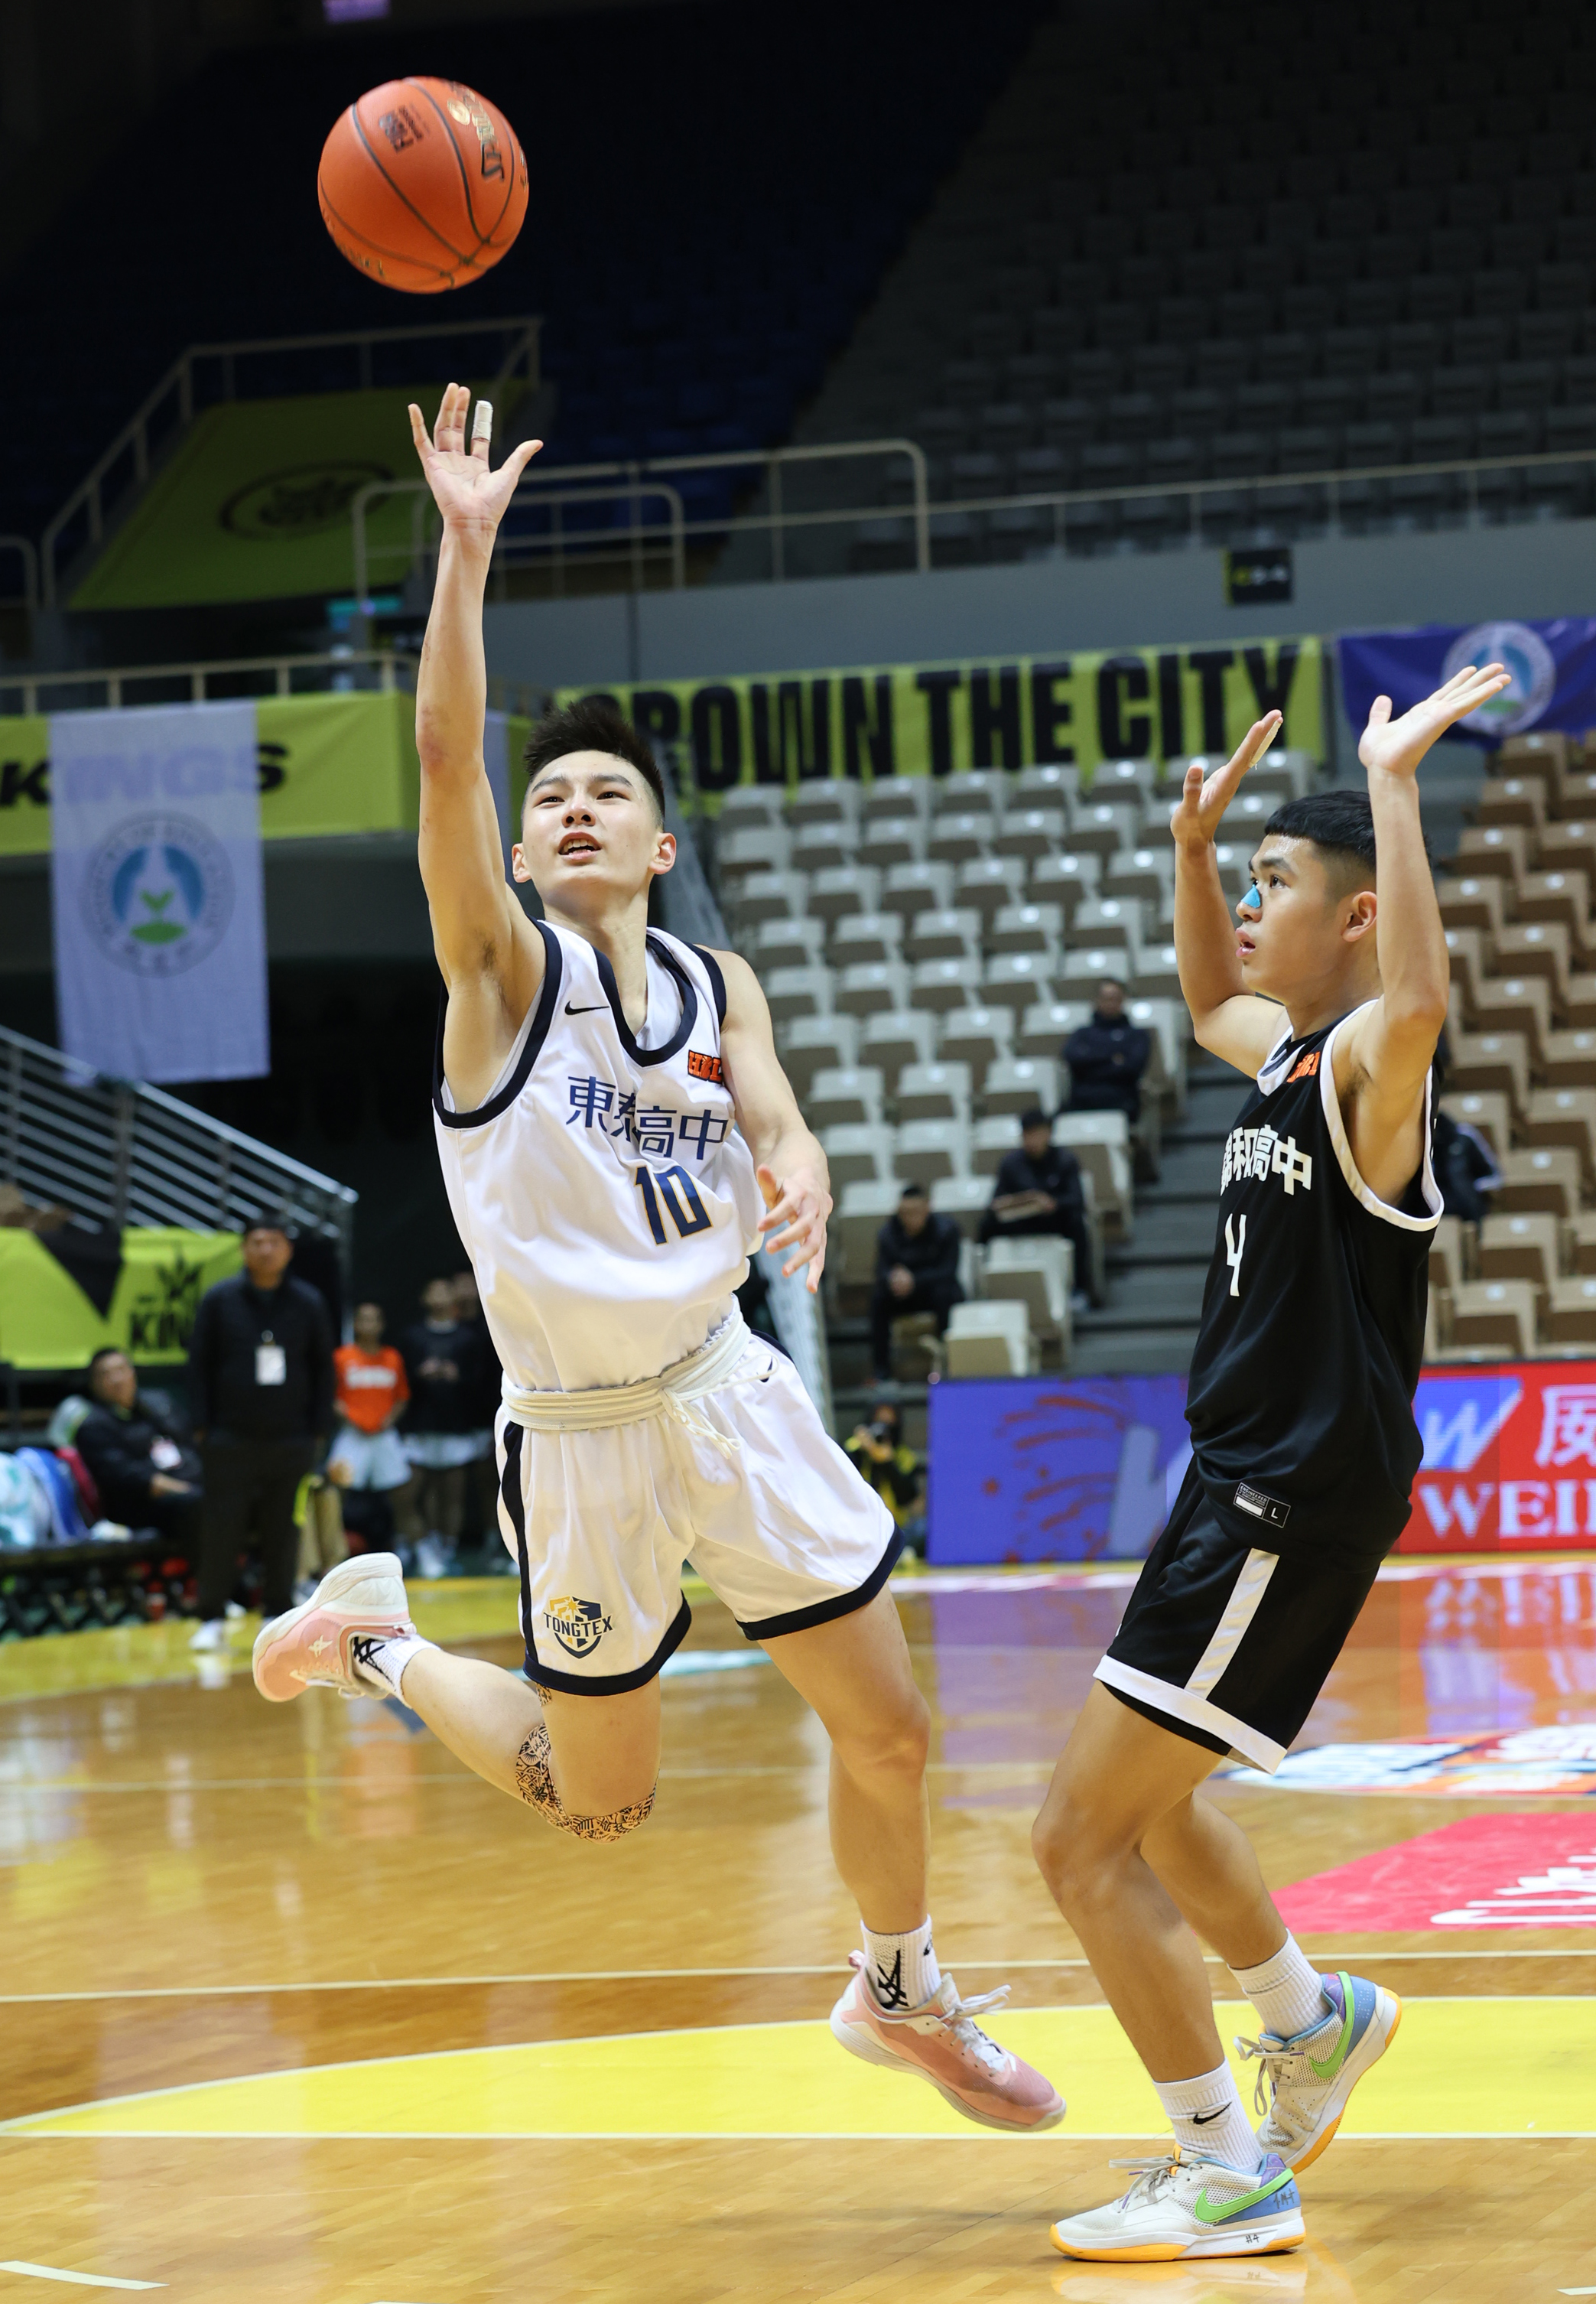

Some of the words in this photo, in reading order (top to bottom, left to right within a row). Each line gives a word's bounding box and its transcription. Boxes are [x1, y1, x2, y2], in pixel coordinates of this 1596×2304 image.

[579, 676, 893, 790] ROWN
[915, 660, 1076, 776] THE
[1097, 643, 1301, 761] CITY
[634, 1165, 713, 1247] 10
[1225, 1213, 1247, 1297] 4
[1240, 1486, 1267, 1502] ENGINEERED
[1271, 1507, 1278, 1519] L
[543, 1612, 613, 1637] TONGTEX
